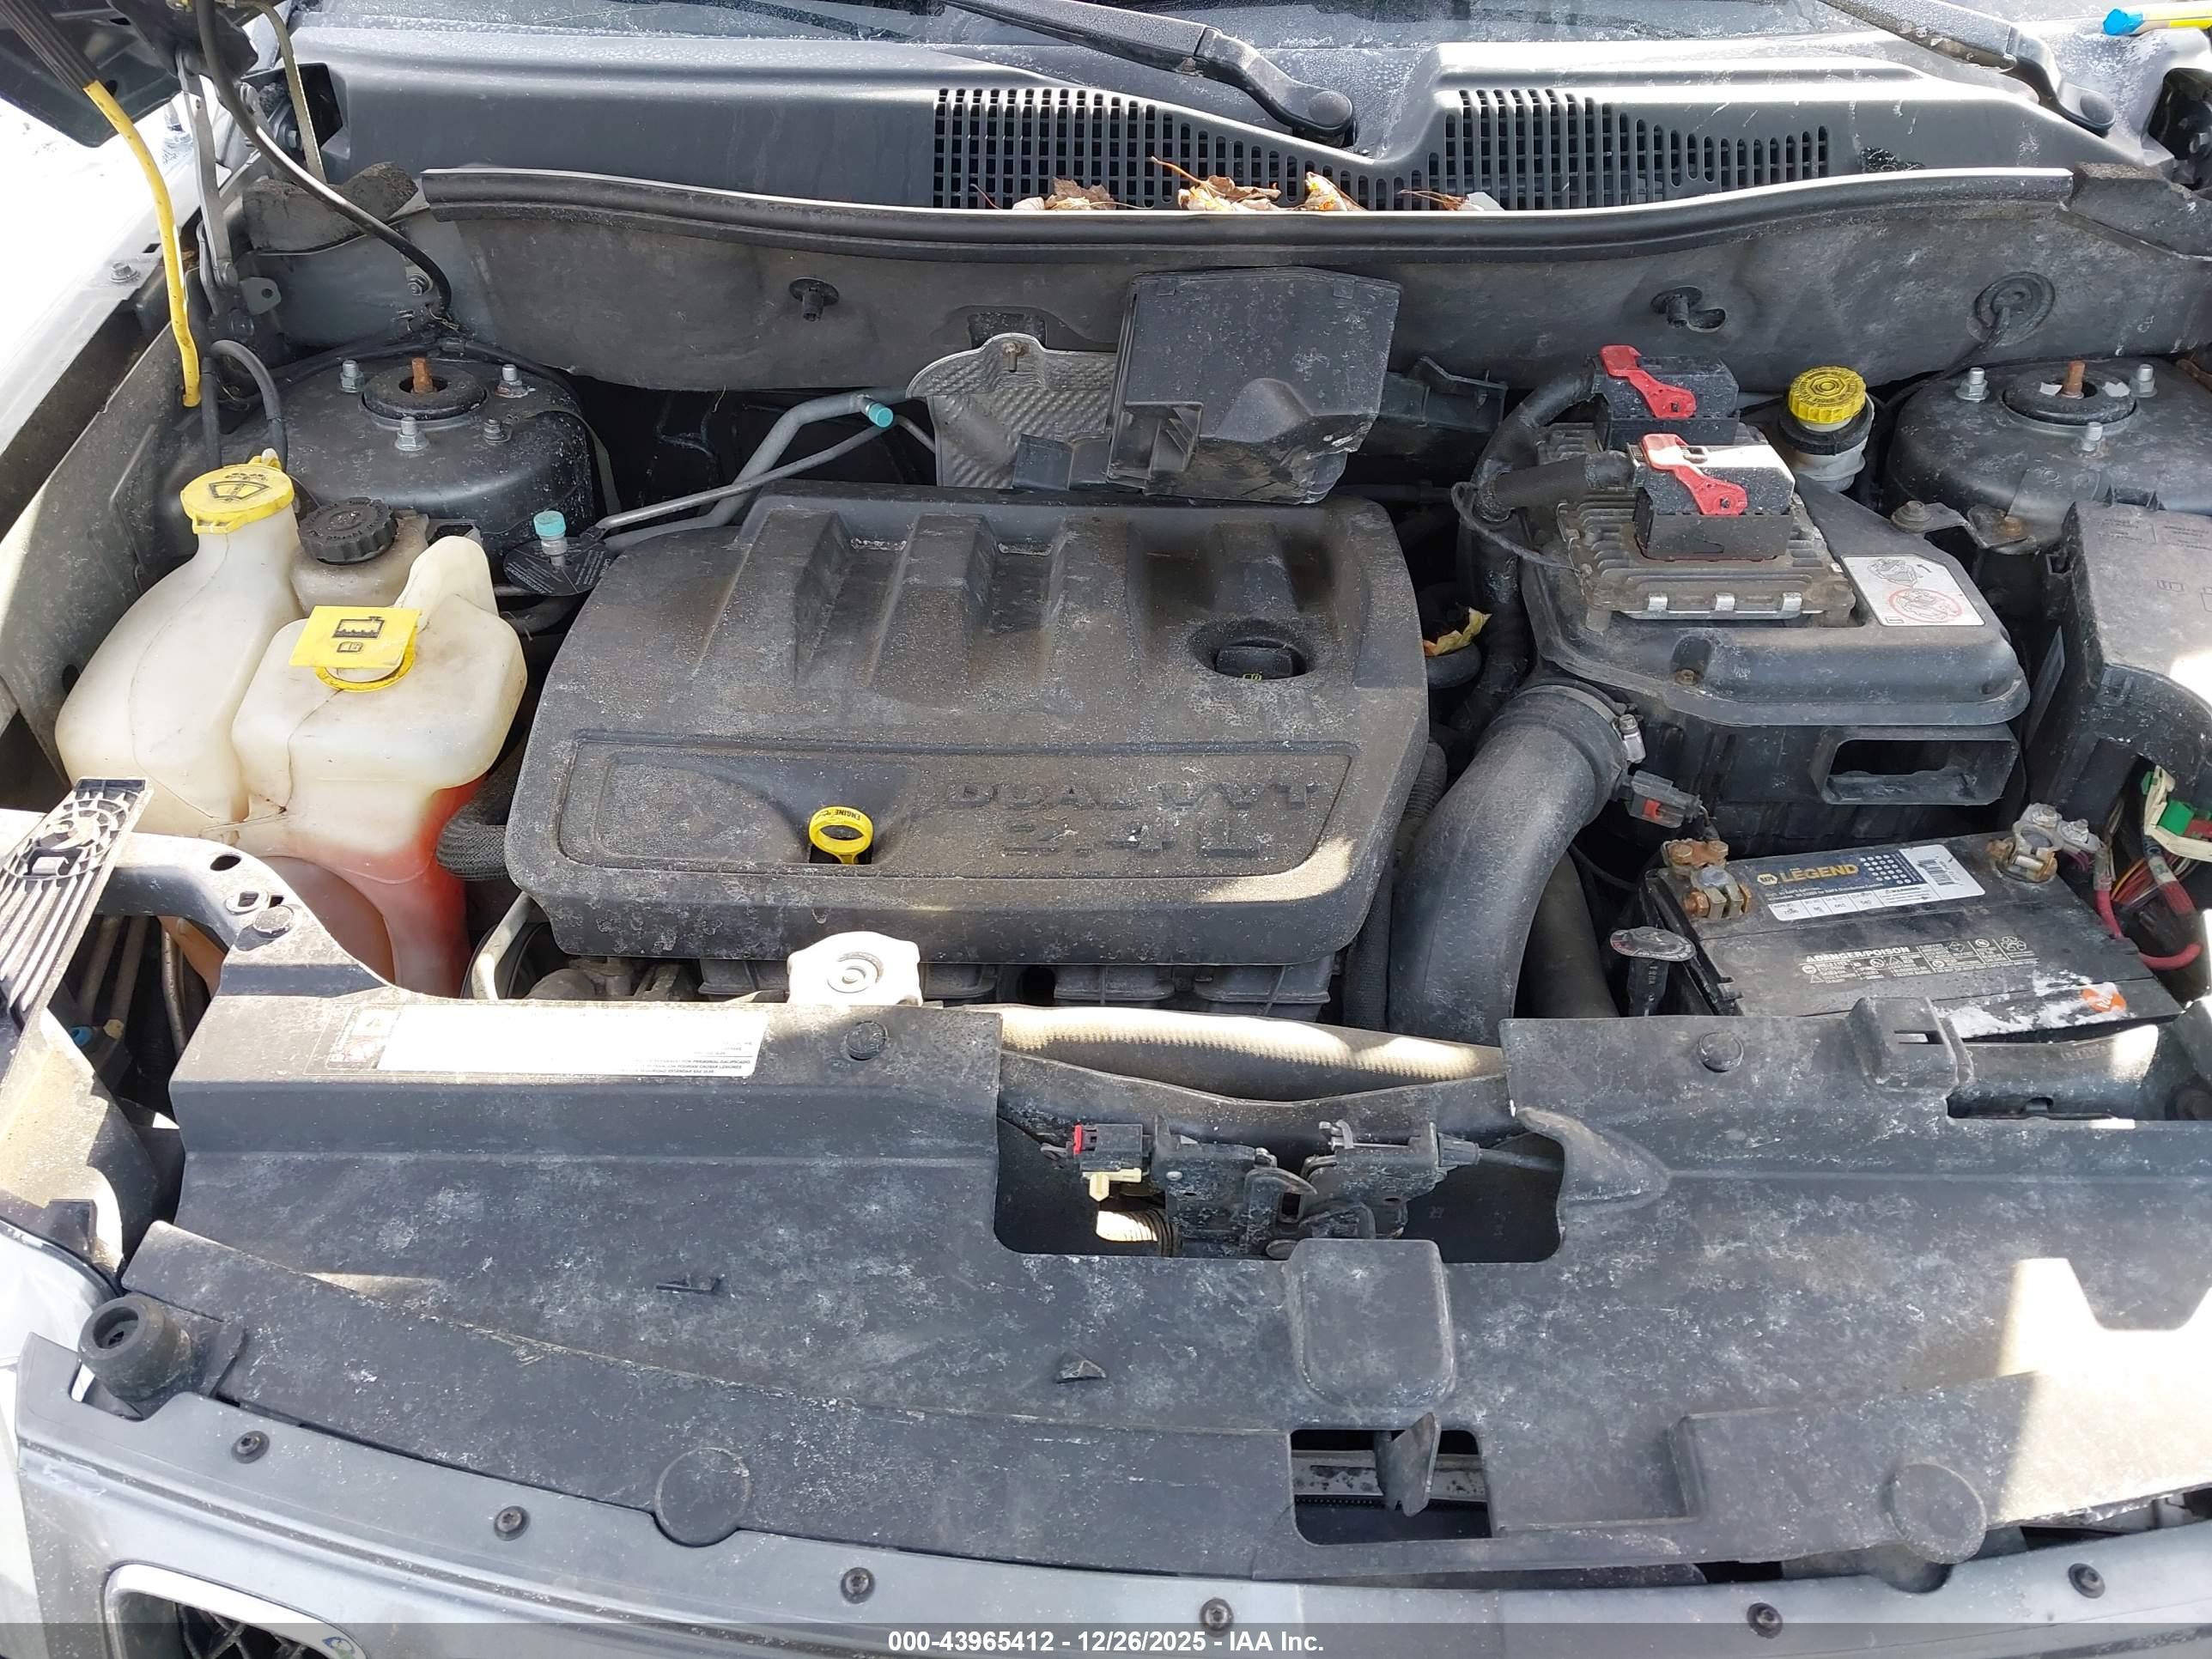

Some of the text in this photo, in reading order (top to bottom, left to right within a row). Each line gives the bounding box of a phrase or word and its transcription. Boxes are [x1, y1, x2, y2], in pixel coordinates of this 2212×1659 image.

[835, 809, 860, 821] ENGINE
[1779, 865, 1859, 883] LEGEND
[1814, 946, 1910, 962] DANGER/POISON
